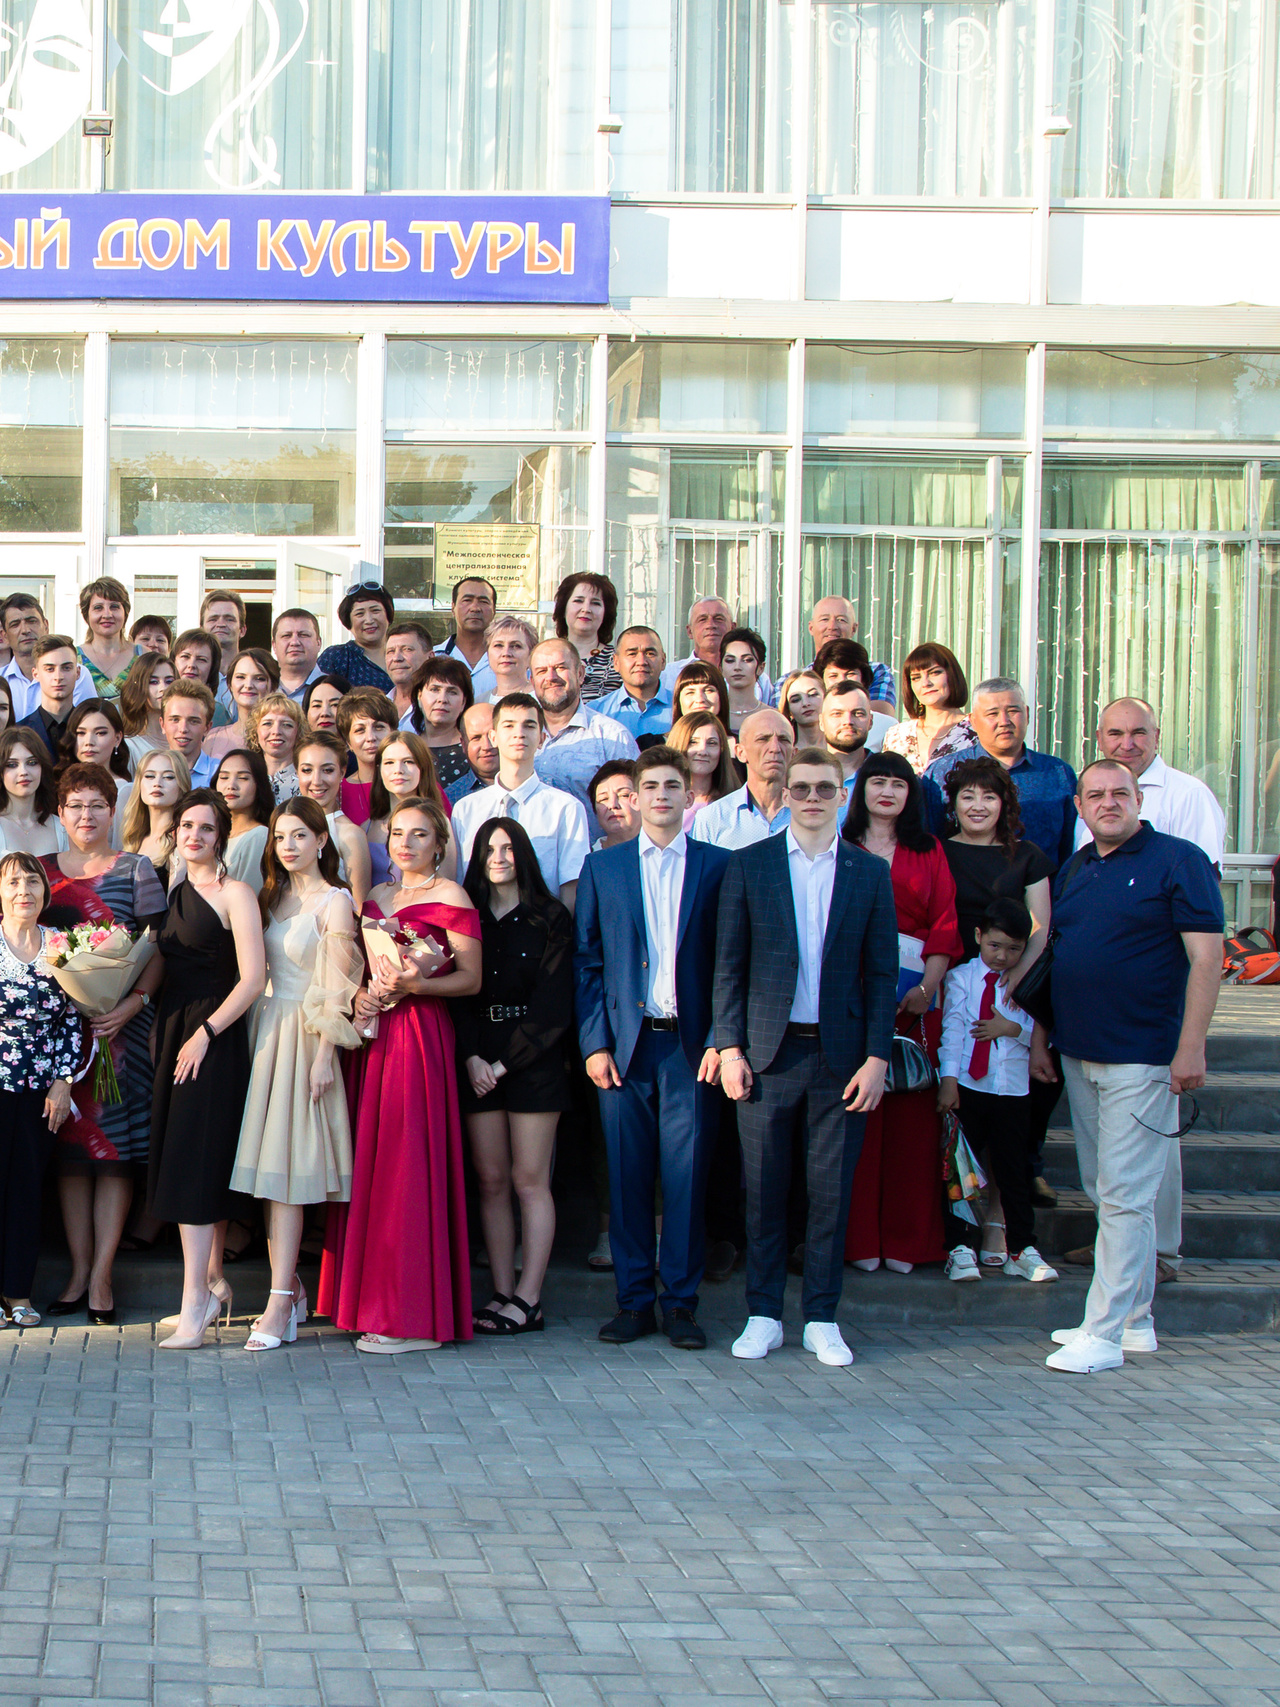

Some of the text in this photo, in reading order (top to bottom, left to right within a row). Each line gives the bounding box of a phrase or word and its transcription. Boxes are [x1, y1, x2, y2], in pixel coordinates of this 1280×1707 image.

[93, 218, 230, 270] ДОМ
[257, 219, 575, 279] КУЛЬТУРЫ
[446, 563, 527, 571] централизованная
